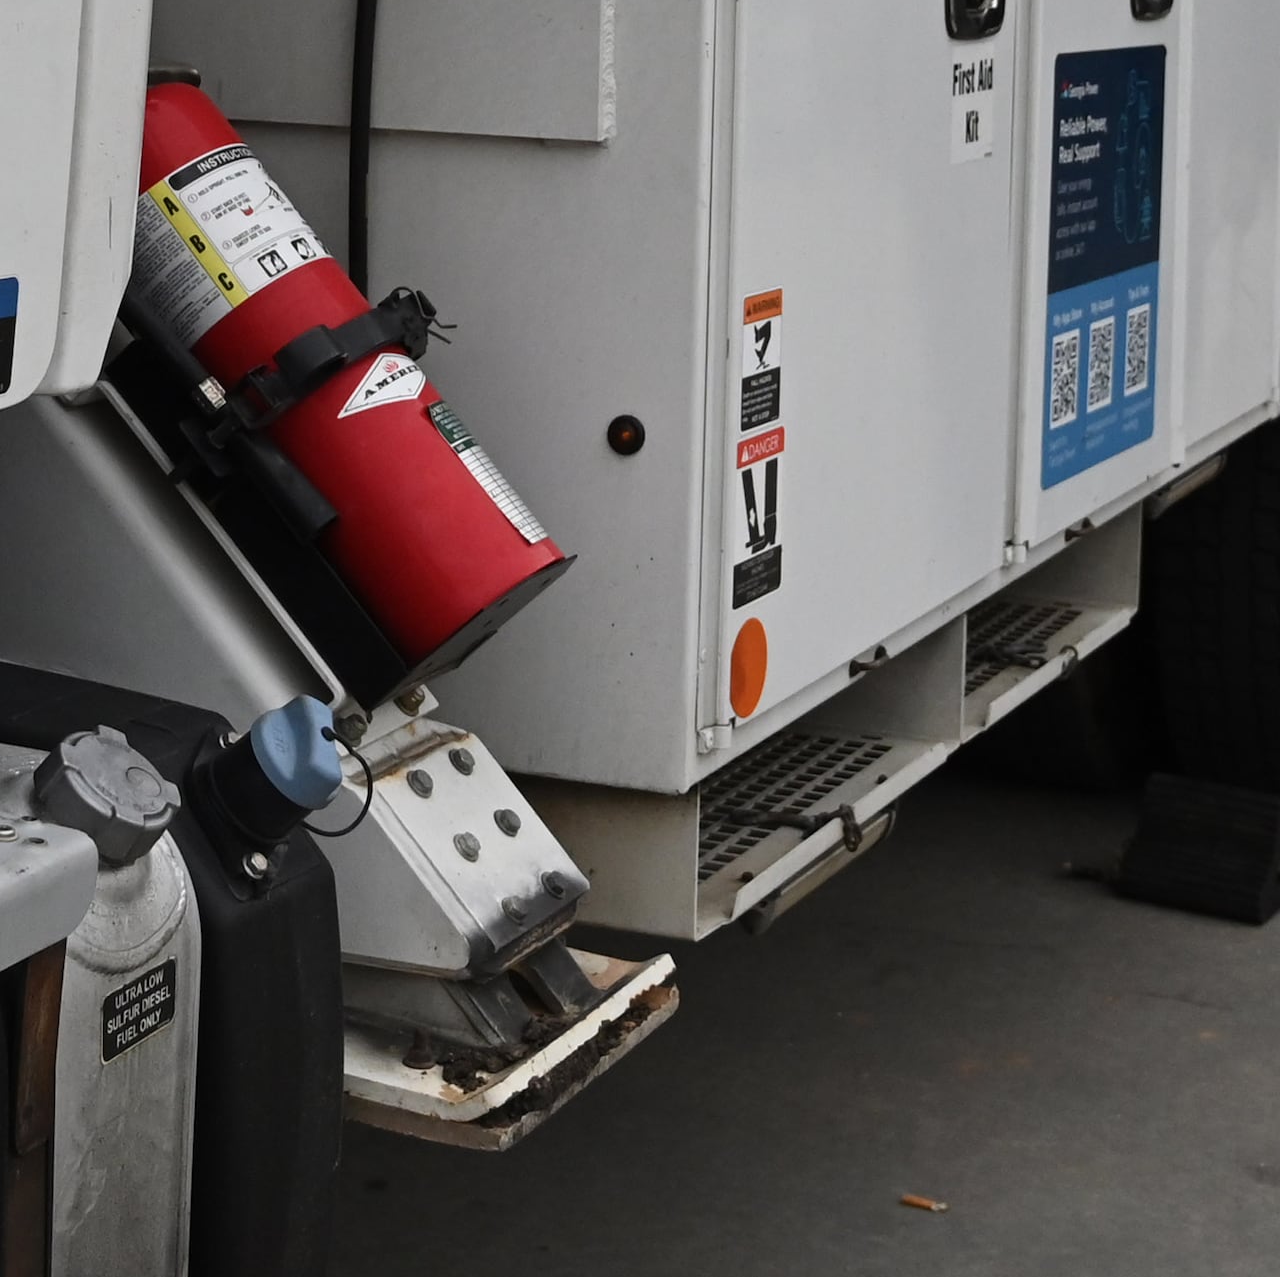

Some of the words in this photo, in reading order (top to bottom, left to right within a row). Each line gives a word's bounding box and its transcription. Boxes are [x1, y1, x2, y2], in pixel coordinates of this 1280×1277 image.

[952, 62, 975, 96] First
[978, 58, 993, 91] Aid
[965, 110, 979, 143] Kit
[1060, 117, 1086, 137] Reliable
[1059, 145, 1074, 164] Real
[1074, 141, 1100, 163] Support
[162, 197, 180, 216] A
[189, 234, 206, 254] B
[218, 272, 234, 291] C
[749, 434, 780, 460] DANGER
[115, 983, 144, 1009] ULTRA
[144, 969, 164, 992] LOW
[107, 1005, 140, 1034] SULFUR
[142, 986, 172, 1012] DIESEL
[116, 1024, 138, 1048] FUEL
[140, 1008, 162, 1032] ONLY
